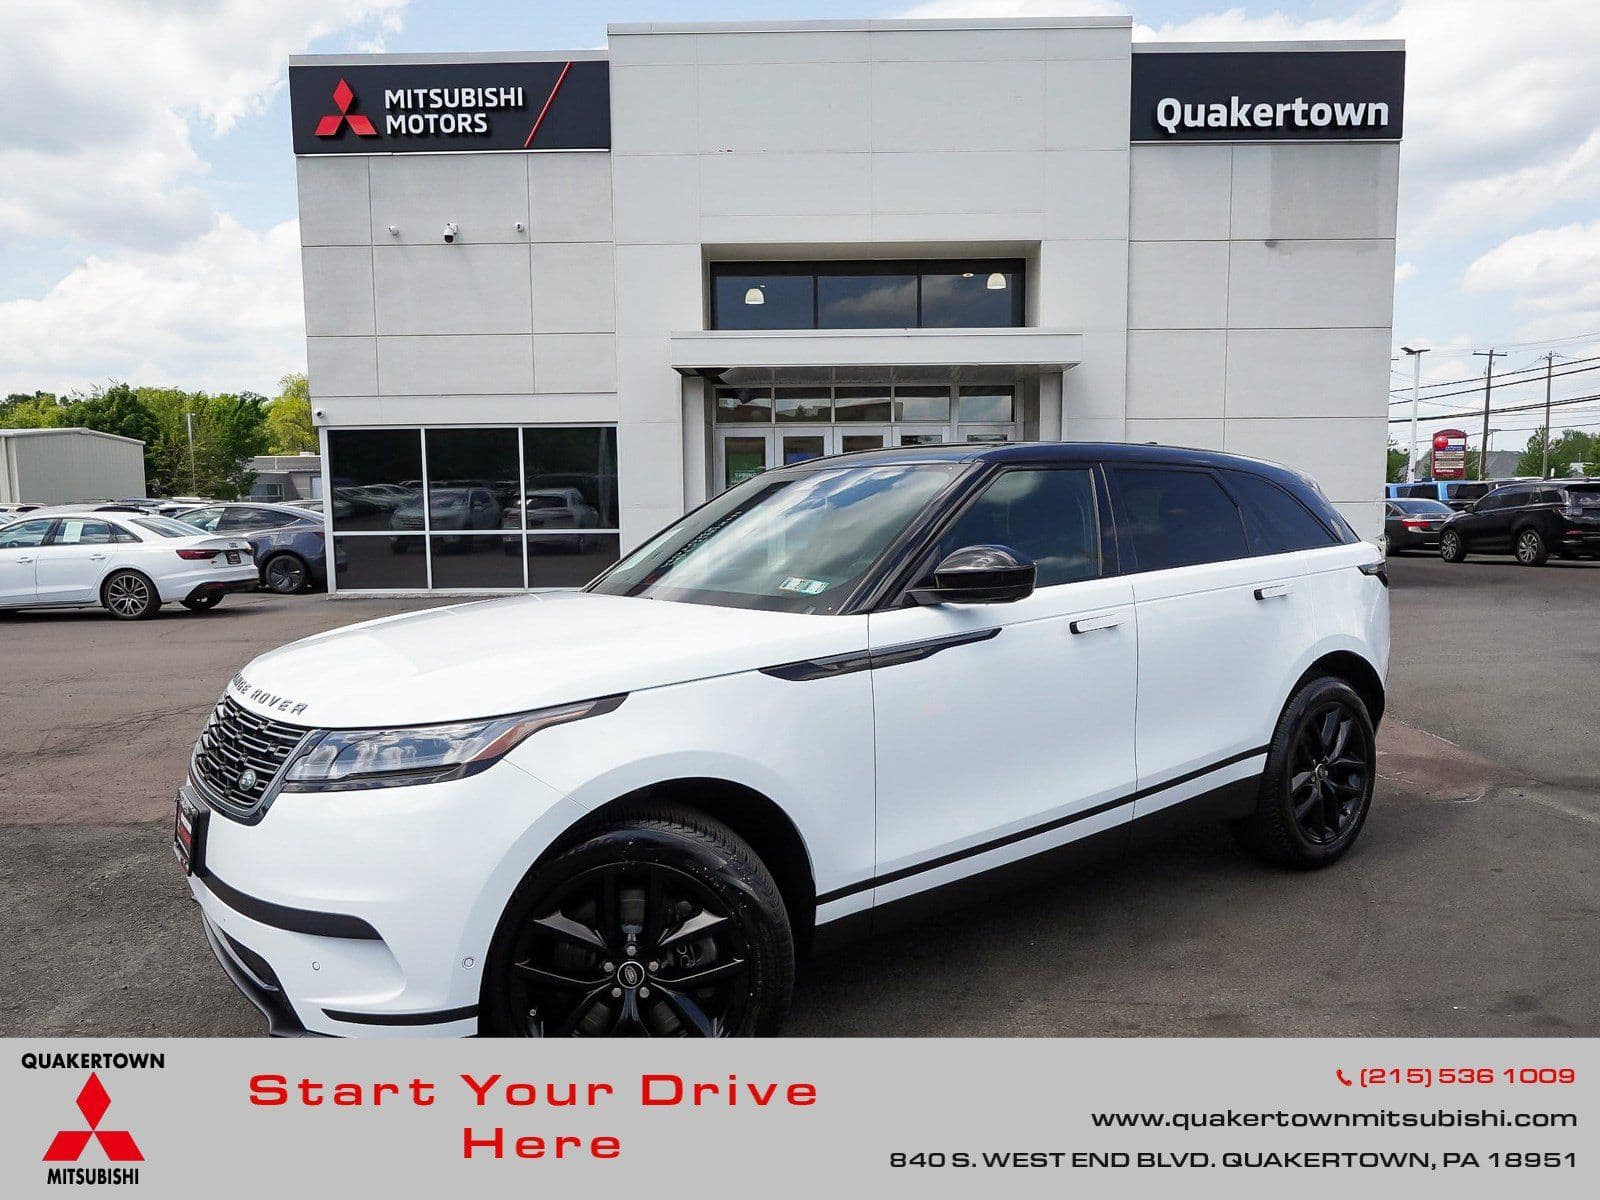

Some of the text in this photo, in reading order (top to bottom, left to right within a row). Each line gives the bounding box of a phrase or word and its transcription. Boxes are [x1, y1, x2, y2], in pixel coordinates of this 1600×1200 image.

[384, 86, 523, 109] MITSUBISHI
[385, 112, 488, 135] MOTORS
[1156, 95, 1390, 134] Quakertown
[250, 688, 308, 715] ROVER
